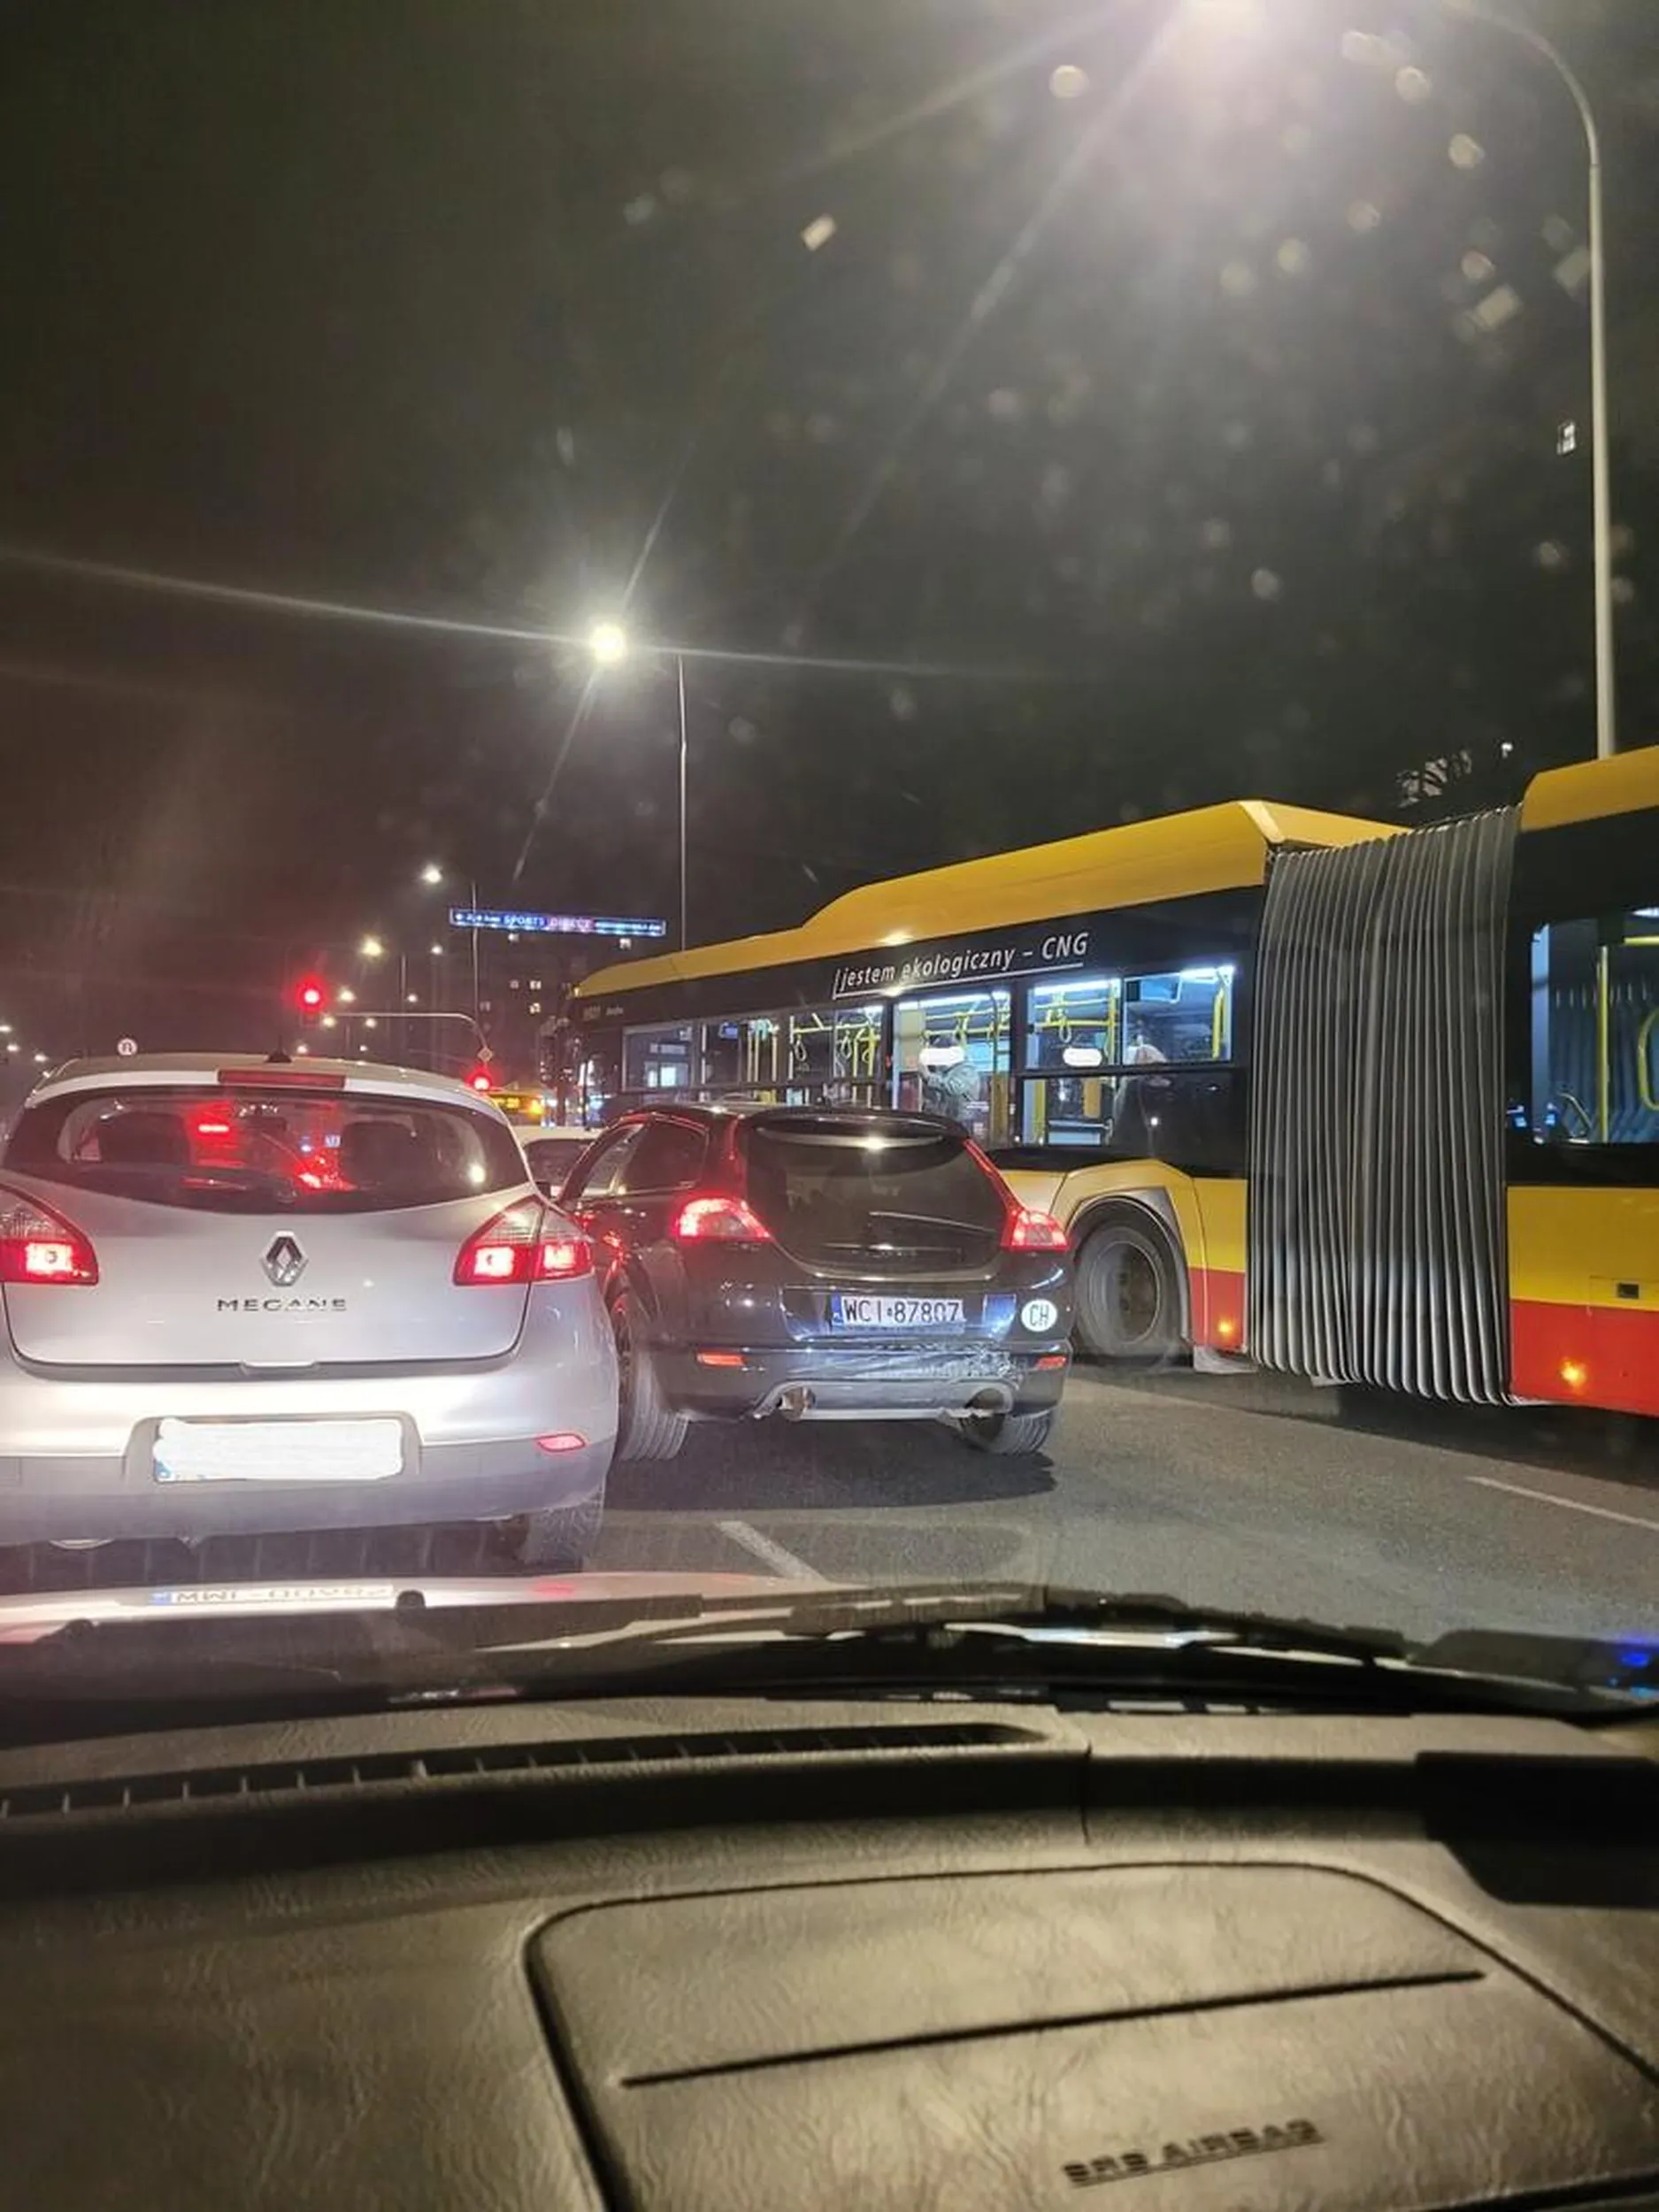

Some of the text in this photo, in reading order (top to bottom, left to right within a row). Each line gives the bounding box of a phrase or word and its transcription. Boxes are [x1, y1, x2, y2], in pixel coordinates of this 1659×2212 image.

[840, 965, 895, 992] jestem
[901, 948, 1016, 982] ekologiczny
[1041, 932, 1089, 961] CNG
[217, 1299, 347, 1311] MEGANE
